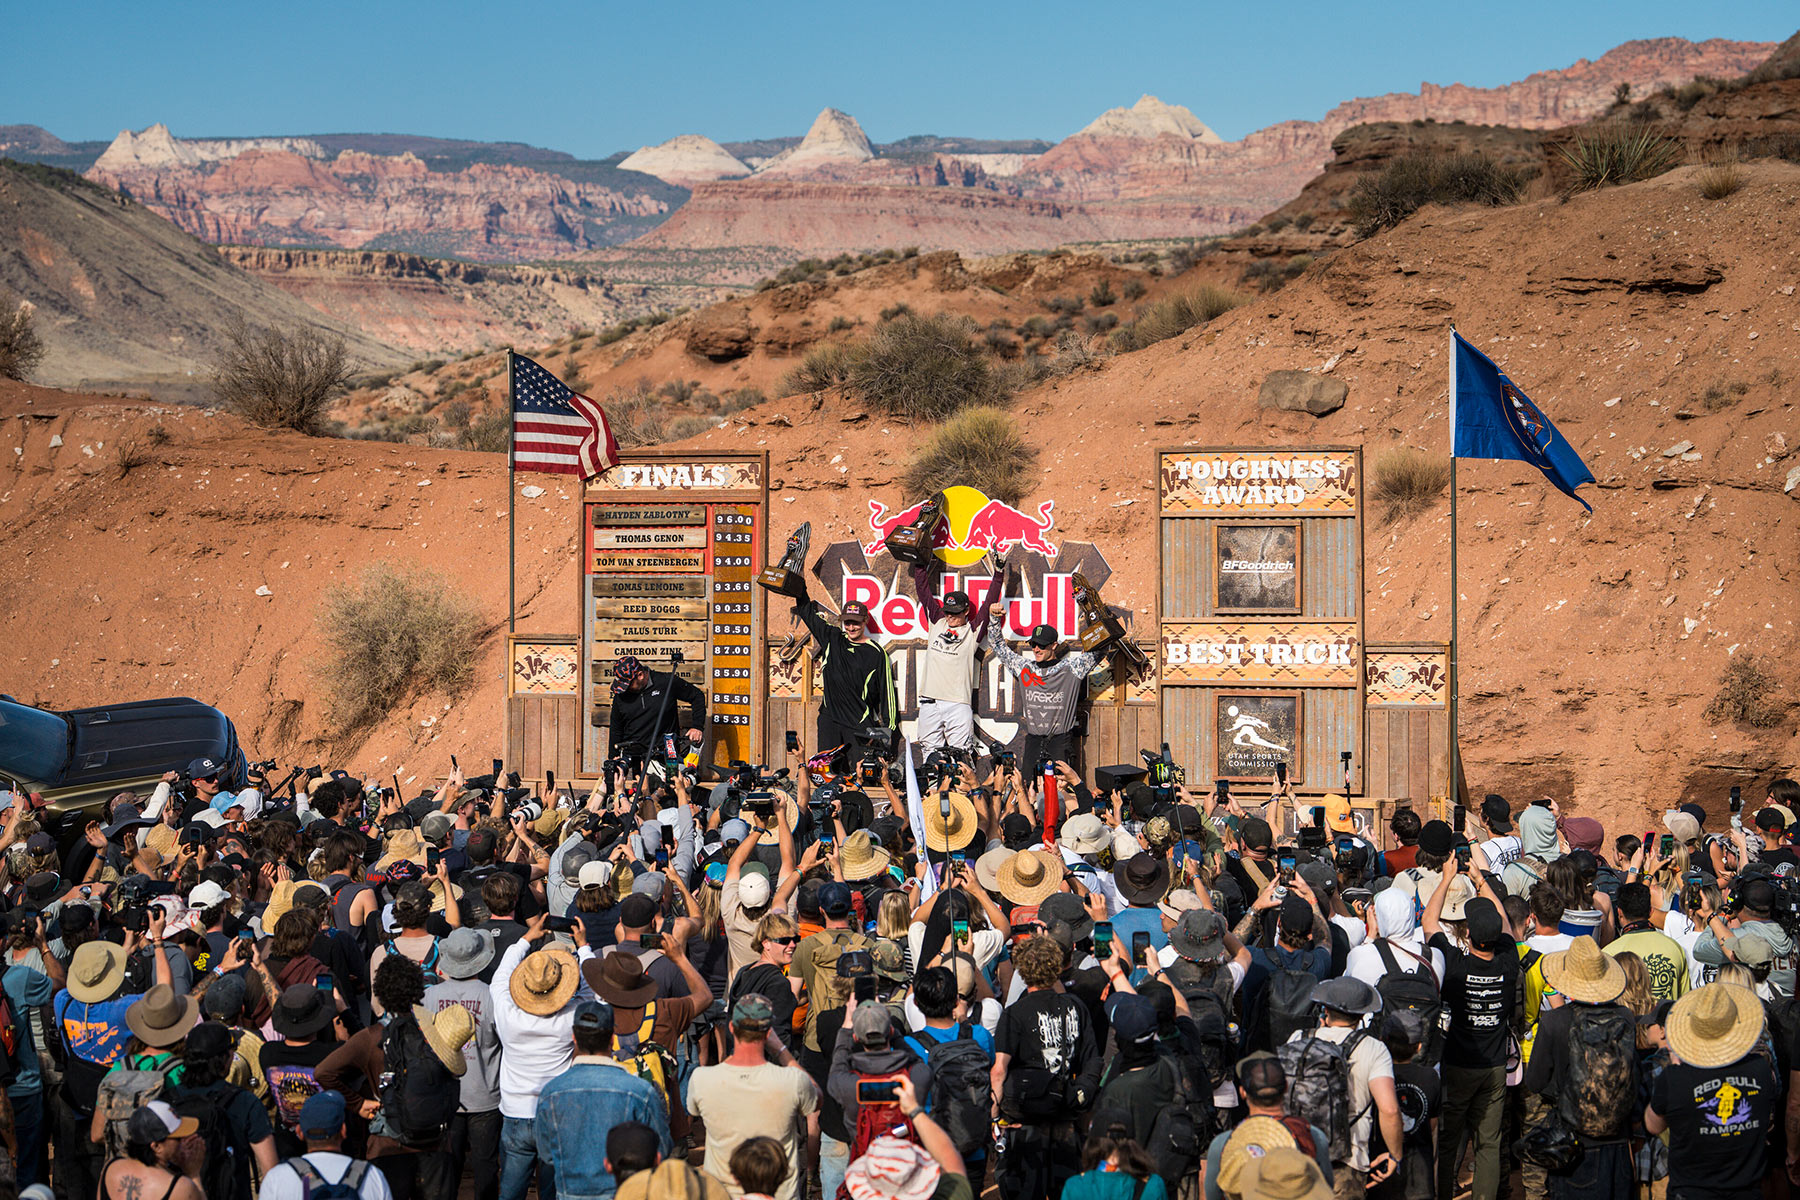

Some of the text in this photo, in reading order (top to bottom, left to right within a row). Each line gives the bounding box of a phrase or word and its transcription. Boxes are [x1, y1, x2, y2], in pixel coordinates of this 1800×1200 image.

[1175, 459, 1341, 480] TOUGHNESS
[622, 466, 726, 487] FINALS
[1202, 486, 1306, 504] AWARD
[605, 510, 690, 519] HAYDEN ZABLOTNY
[717, 515, 752, 525] 96.00
[615, 534, 685, 543] THOMAS GENON
[715, 533, 751, 543] 94.35
[596, 557, 700, 567] TOM VAN STEENBERGEN
[715, 557, 750, 566] 94.00
[784, 559, 792, 567] 2
[1222, 560, 1294, 571] BFGoodrich
[613, 583, 685, 591] TOMAS LEMOINE
[715, 582, 750, 591] 93.66
[623, 605, 681, 614] REED BOGGS
[715, 604, 750, 613] 90.33
[1089, 612, 1097, 621] 3
[623, 627, 678, 635] TALUS TURK
[714, 625, 749, 634] 88.50
[614, 647, 658, 656] CAMERON
[660, 647, 683, 655] ZINK
[714, 646, 749, 655] 87.00
[1166, 643, 1351, 665] BEST TRICK
[714, 669, 749, 677] 85.90
[714, 694, 749, 704] 85.50
[713, 715, 748, 724] 85.33
[1693, 1076, 1761, 1098] RED BULL
[1700, 1119, 1760, 1135] RAMPAGE
